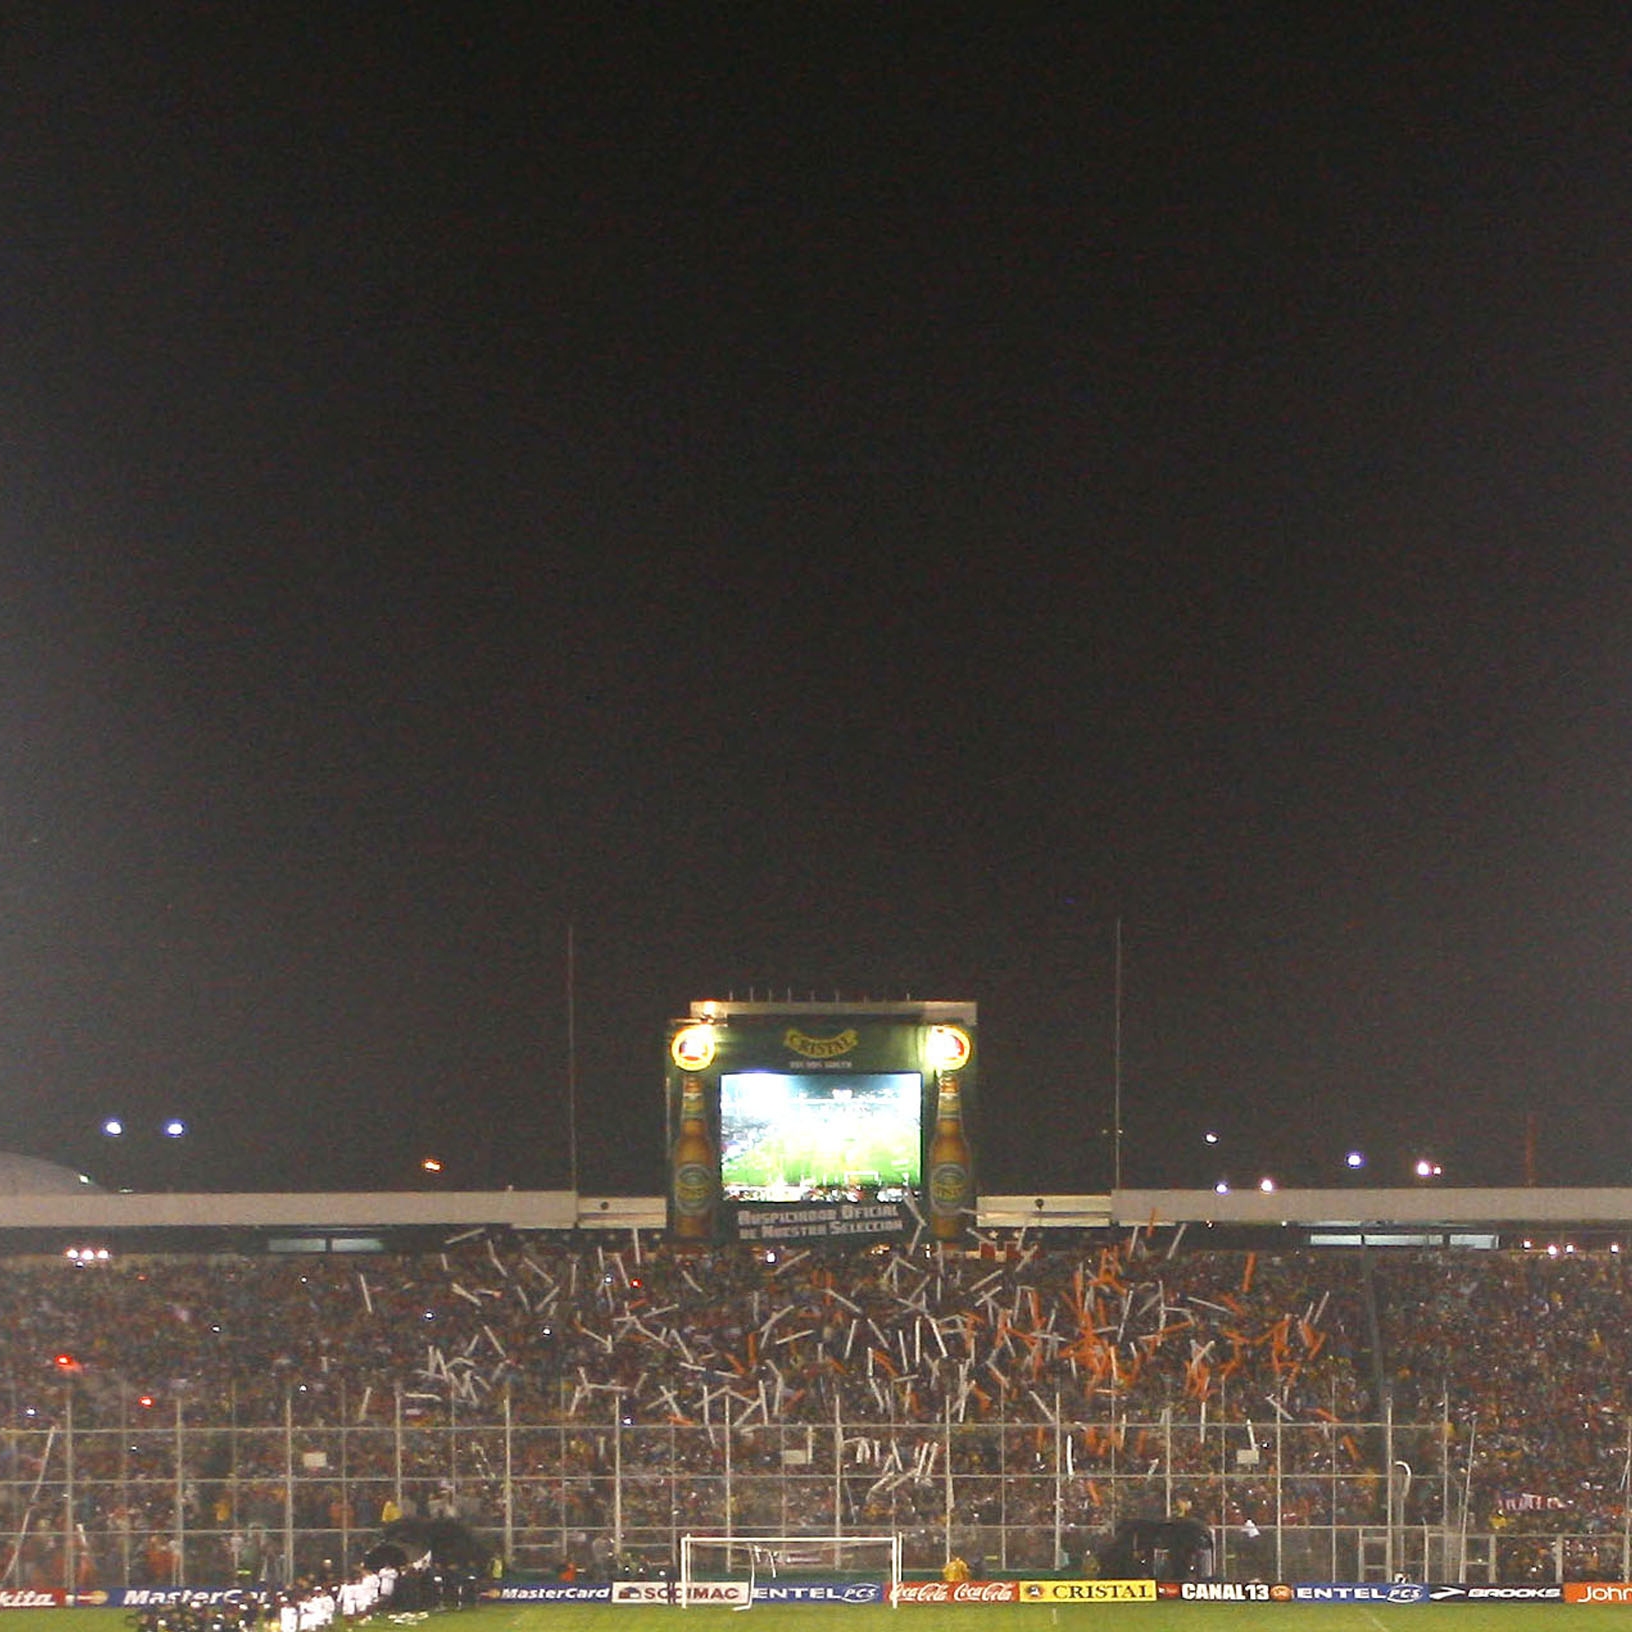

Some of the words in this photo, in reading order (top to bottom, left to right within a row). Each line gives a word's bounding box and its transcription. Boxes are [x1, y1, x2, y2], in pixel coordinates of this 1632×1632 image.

[501, 1586, 611, 1600] MasterCard
[752, 1587, 843, 1600] ENTEL
[1052, 1584, 1153, 1600] CRISTAL
[1297, 1587, 1387, 1599] ENTEL
[1387, 1587, 1423, 1600] PCS
[1468, 1587, 1562, 1599] BROOKS
